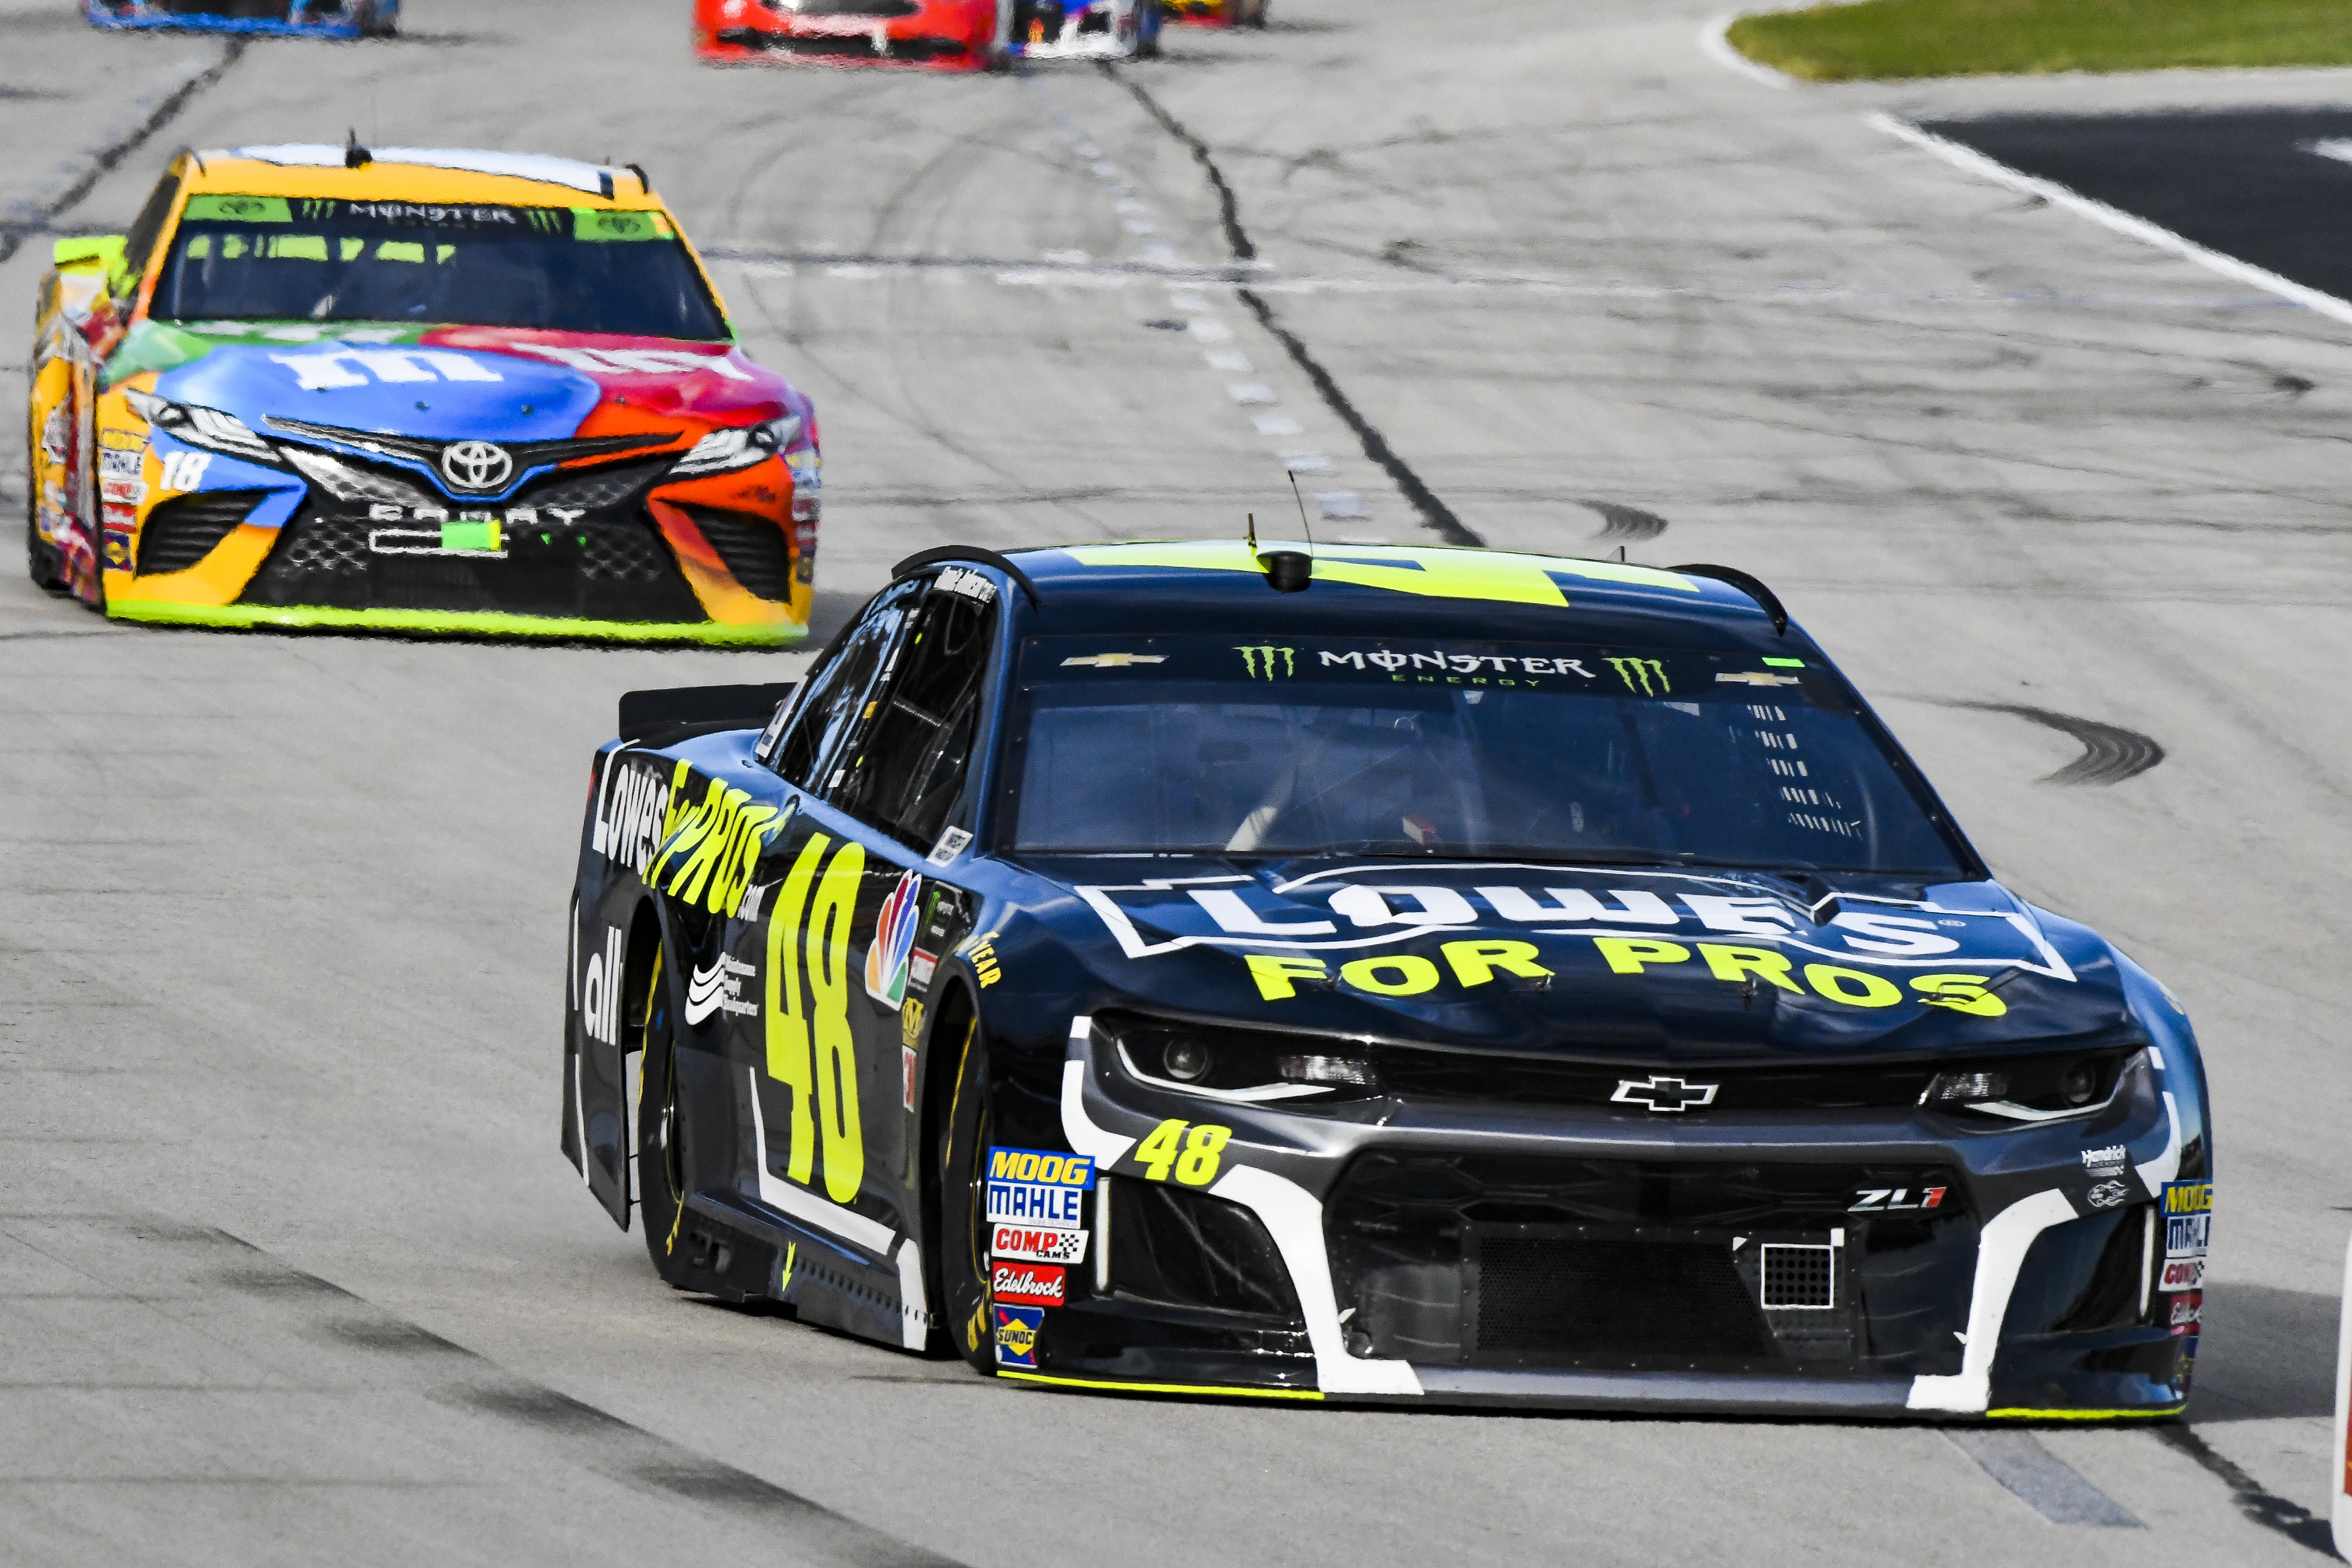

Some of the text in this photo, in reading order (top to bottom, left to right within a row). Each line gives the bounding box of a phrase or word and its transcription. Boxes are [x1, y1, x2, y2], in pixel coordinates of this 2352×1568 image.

[161, 450, 212, 492] 18
[1318, 650, 1596, 678] MONSTER
[1393, 675, 1539, 686] ENERGY
[1244, 937, 2007, 1016] FOR PROS
[765, 832, 864, 1203] 48
[989, 1152, 1091, 1184] MOOG
[1134, 1119, 1232, 1186] 48
[988, 1184, 1078, 1220] MAHLE
[1847, 1186, 1946, 1212] ZL1
[996, 1228, 1058, 1252] COMP
[1036, 1250, 1070, 1259] CAMS
[993, 1267, 1063, 1298] Edelbrock
